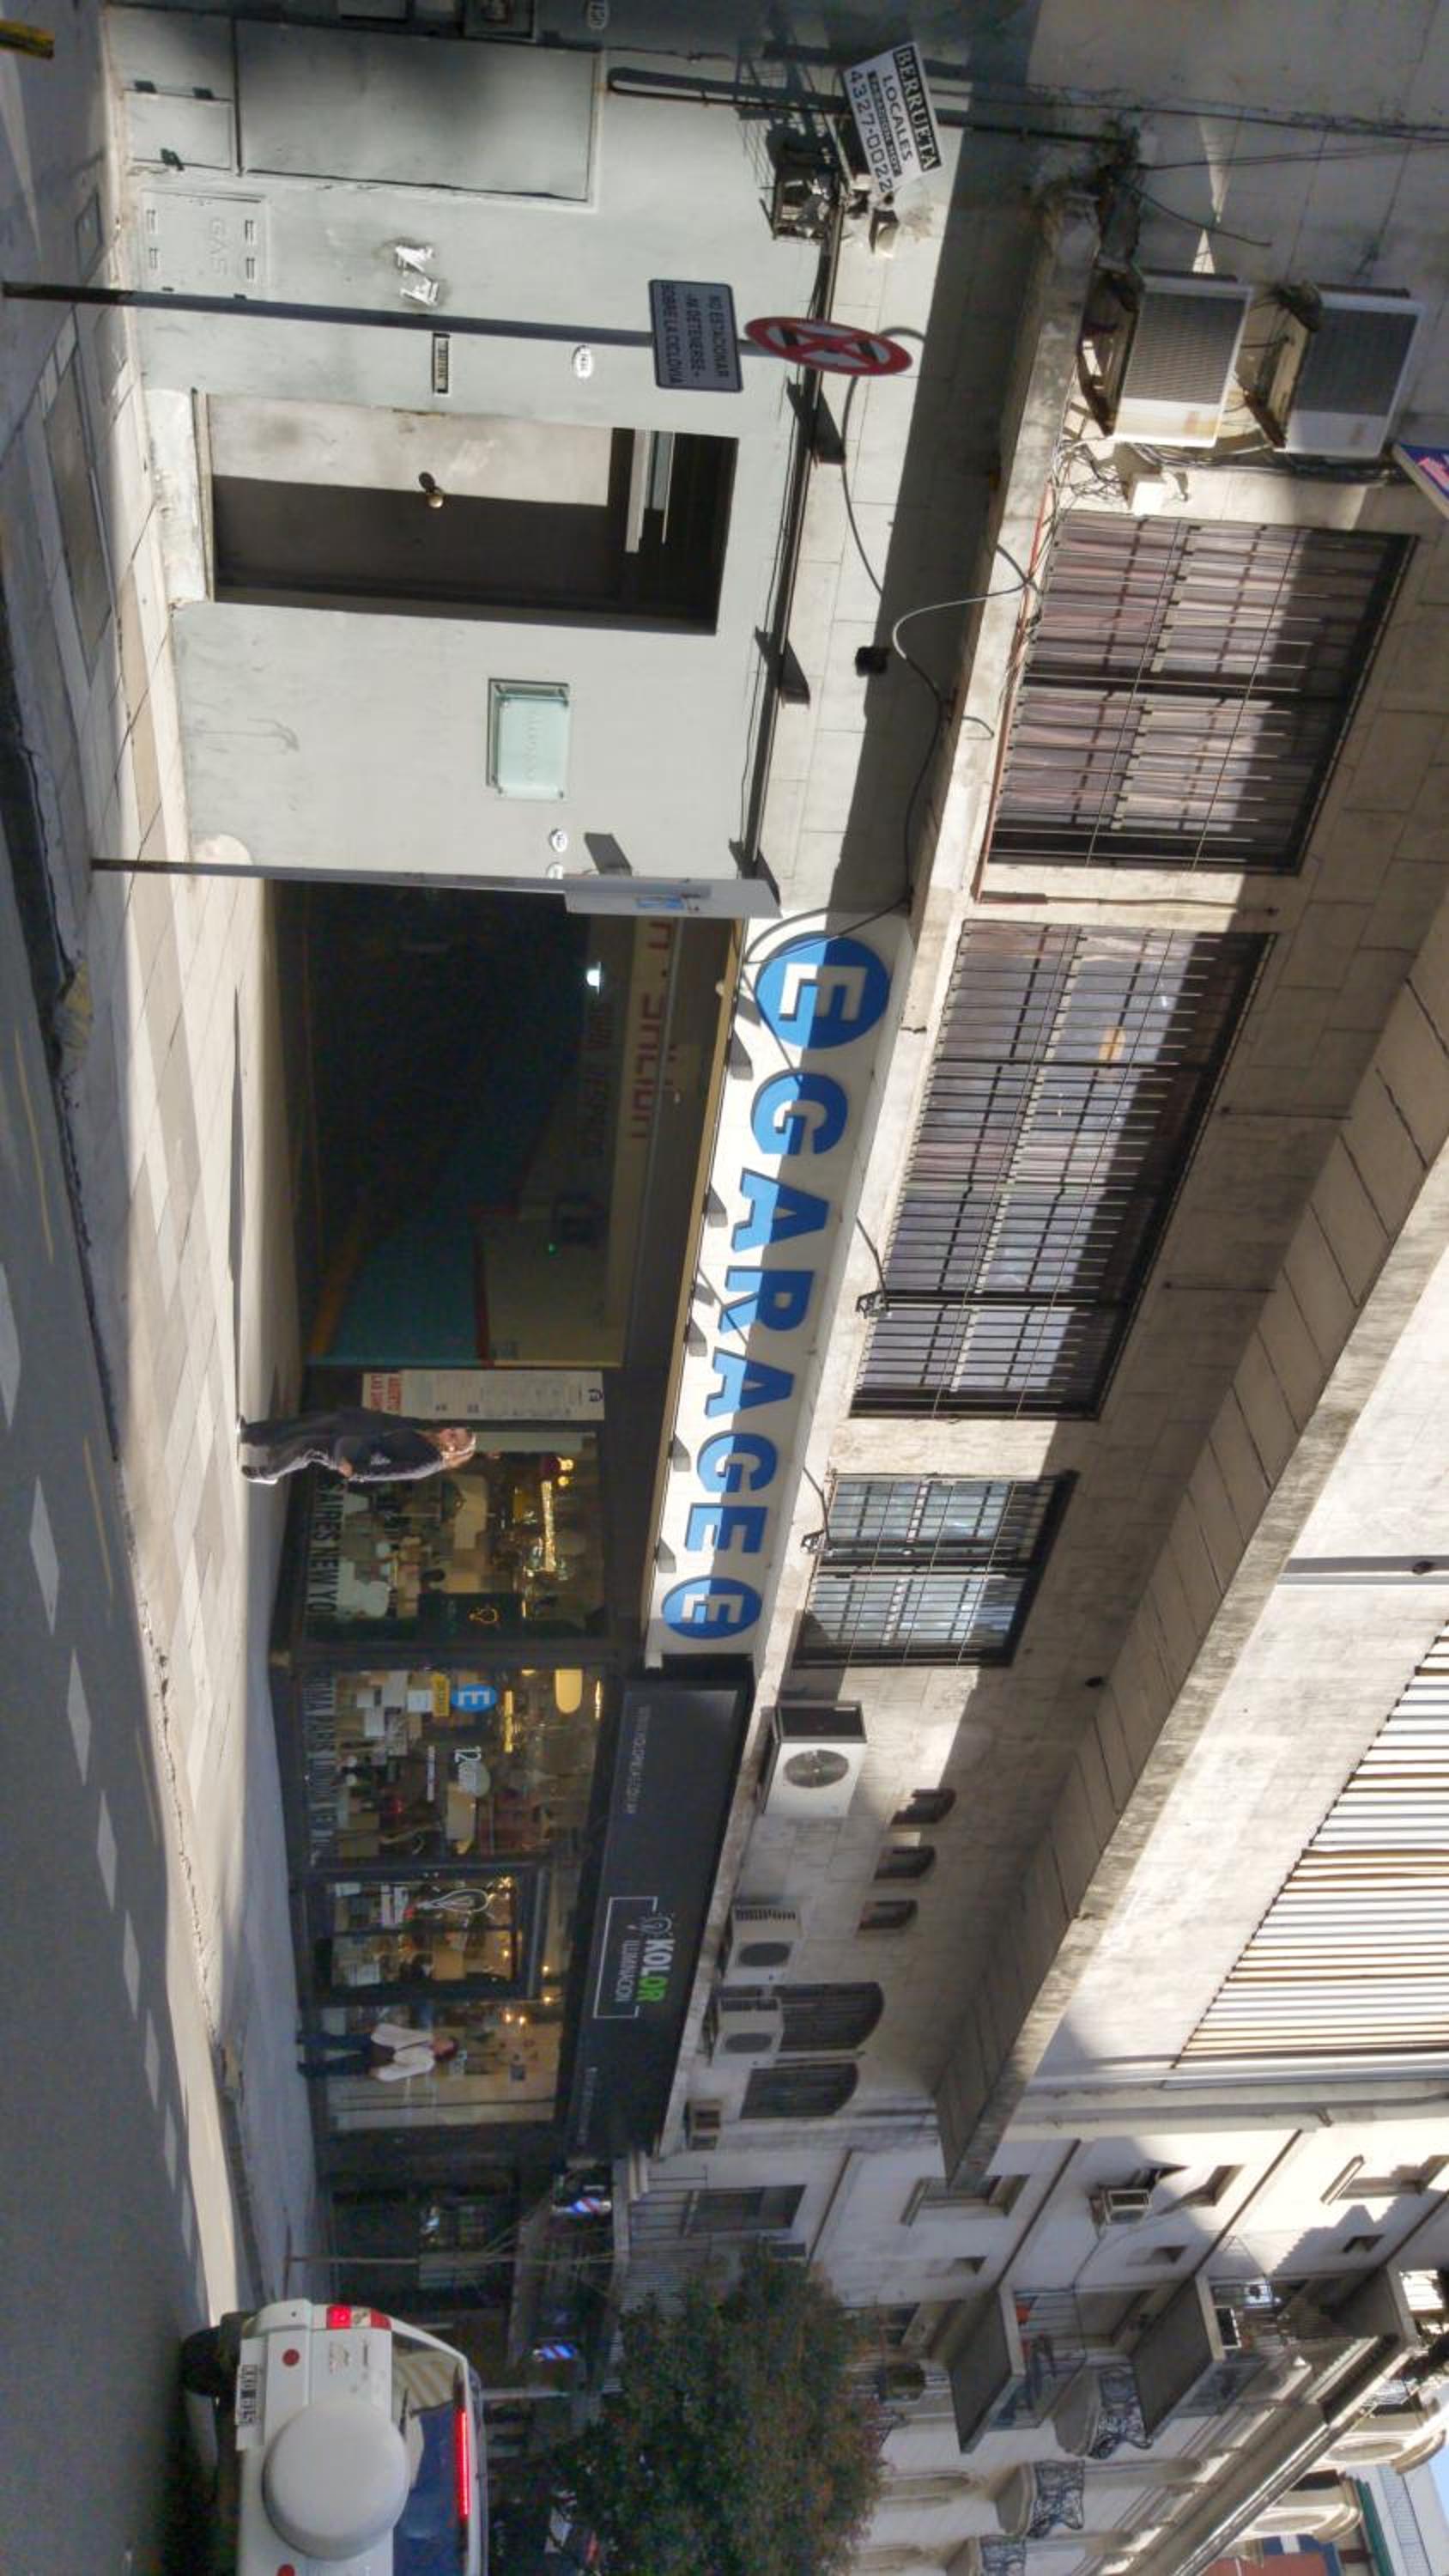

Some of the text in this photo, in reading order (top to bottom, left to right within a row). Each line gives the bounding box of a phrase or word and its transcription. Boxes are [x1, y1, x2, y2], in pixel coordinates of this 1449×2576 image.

[882, 76, 912, 161] LOCALES
[897, 50, 937, 169] BERRUETA
[661, 284, 684, 384] SOBRE LA CICLOVIA
[709, 295, 730, 378] NO ESTACIONAR
[683, 1071, 849, 1554] GARAGE
[309, 1546, 340, 1585] NEW
[637, 1939, 676, 2002] KOLOR
